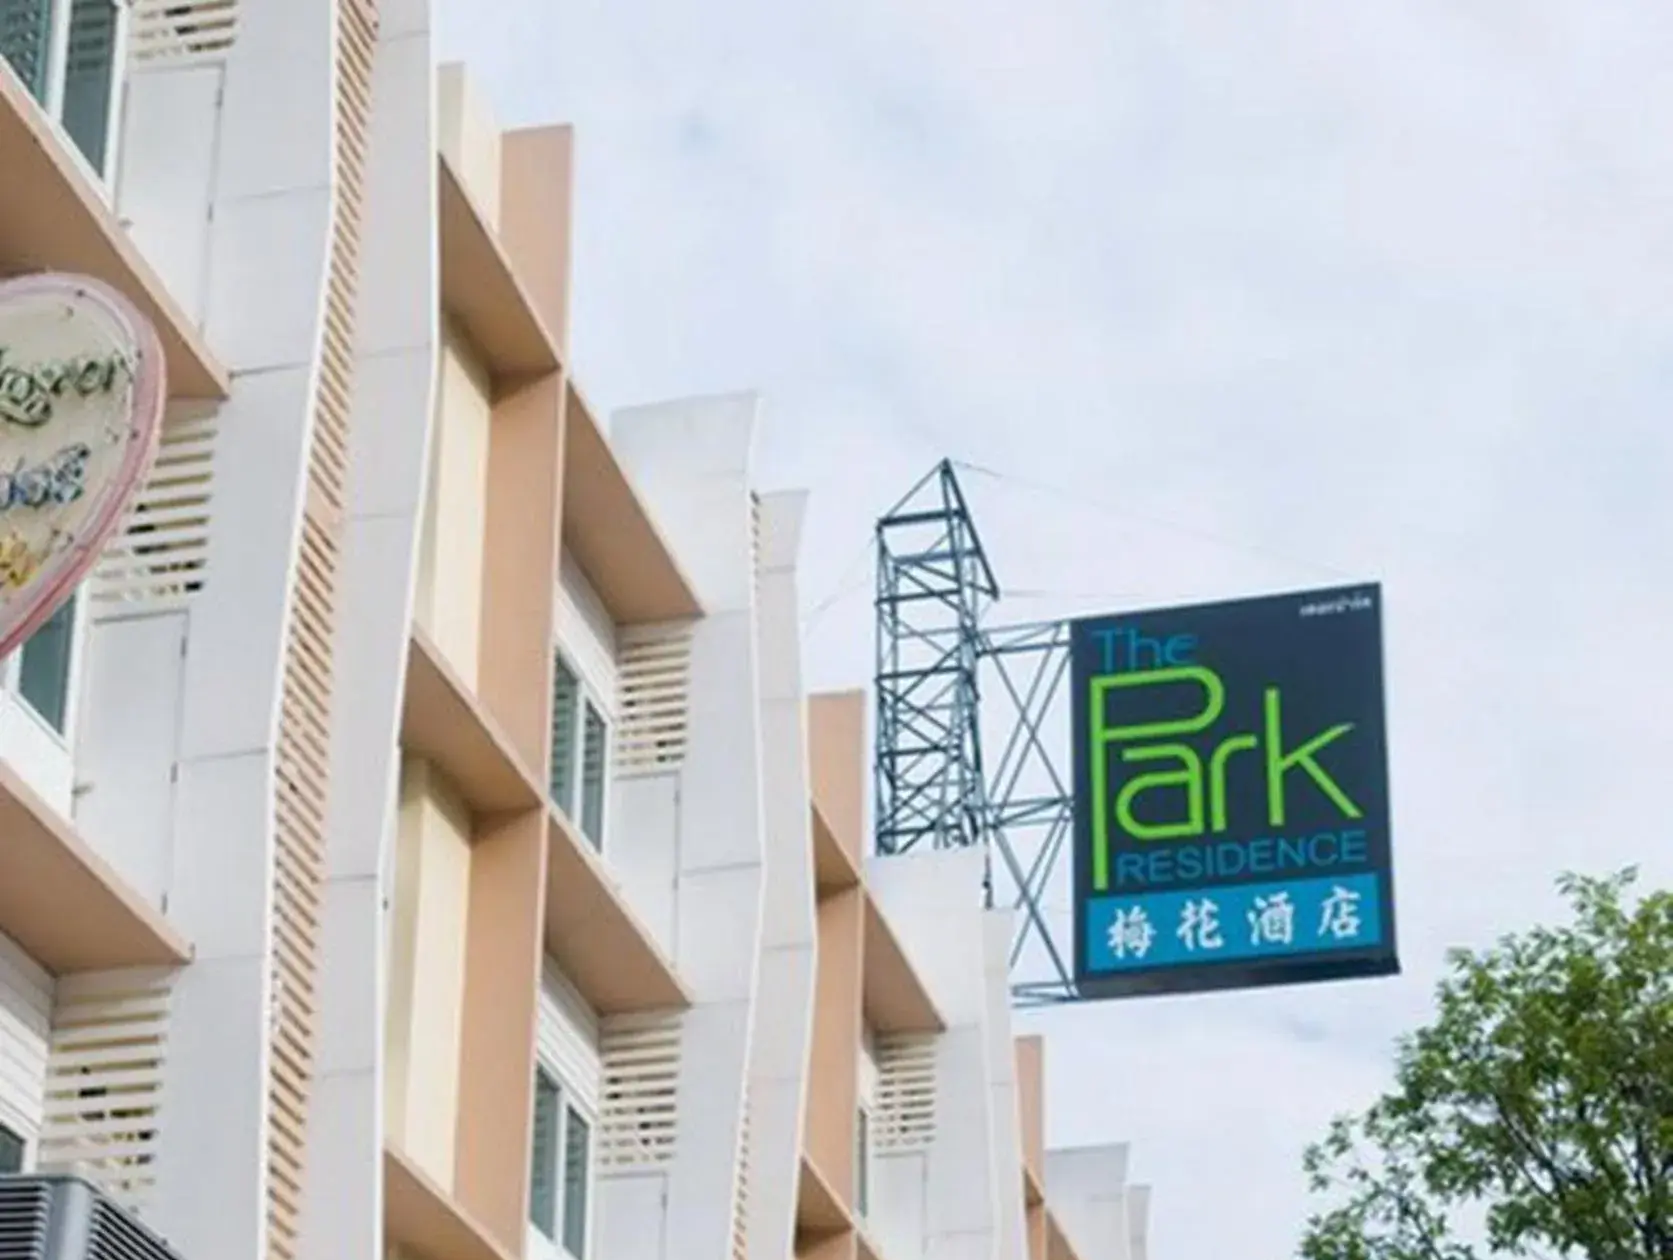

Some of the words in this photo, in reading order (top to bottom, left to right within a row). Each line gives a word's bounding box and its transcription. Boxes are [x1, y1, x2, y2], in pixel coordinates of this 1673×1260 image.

[1091, 626, 1199, 673] The
[1089, 665, 1363, 891] Park
[1115, 829, 1368, 886] RESIDENCE
[1106, 884, 1363, 960] 梅花酒店
